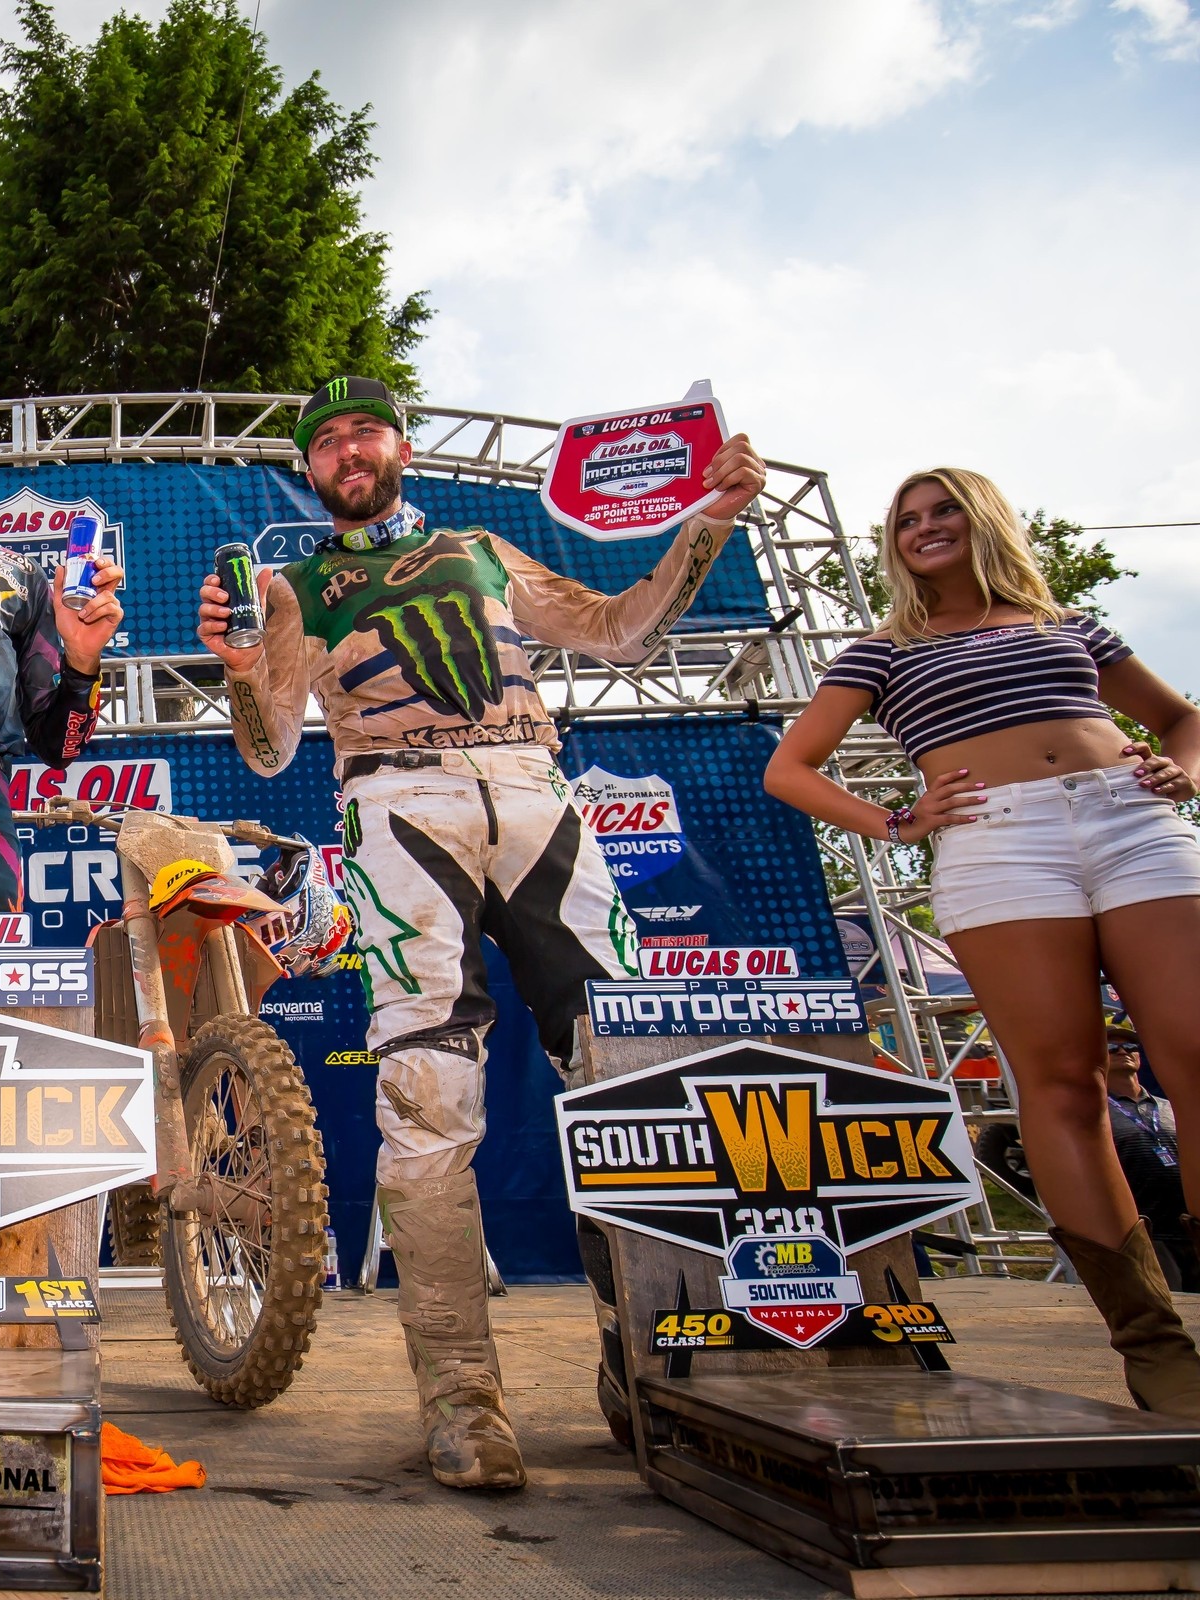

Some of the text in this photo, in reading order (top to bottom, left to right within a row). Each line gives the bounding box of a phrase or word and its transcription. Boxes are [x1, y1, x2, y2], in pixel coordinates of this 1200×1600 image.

[602, 411, 672, 433] LUCAS OIL
[599, 438, 672, 459] LUCAS OIL
[585, 456, 686, 480] MOTOCROSS
[584, 502, 682, 522] 250 POINTS LEADER
[592, 496, 676, 512] RND 6: SOUTHWICK
[605, 512, 667, 525] JUNE 29, 2019
[321, 568, 368, 607] PPG
[62, 710, 87, 759] Red Bull
[405, 715, 535, 748] Kawasaki
[76, 763, 162, 813] OIL
[607, 790, 671, 800] PERFORMANCE
[597, 840, 681, 857] RODUCTS
[649, 949, 791, 976] LUCAS OIL
[689, 981, 757, 991] PRO
[594, 992, 860, 1022] MOTOCROSS
[598, 1022, 863, 1034] CHAMPIONSHIP
[775, 1243, 813, 1265] MB
[14, 1280, 87, 1317] 1ST
[748, 1282, 837, 1300] SOUTHWICK
[47, 1299, 95, 1309] PLACE
[760, 1309, 834, 1318] NATIONAL
[656, 1304, 936, 1342] 450 3RD
[656, 1325, 947, 1346] CLASS PLACE
